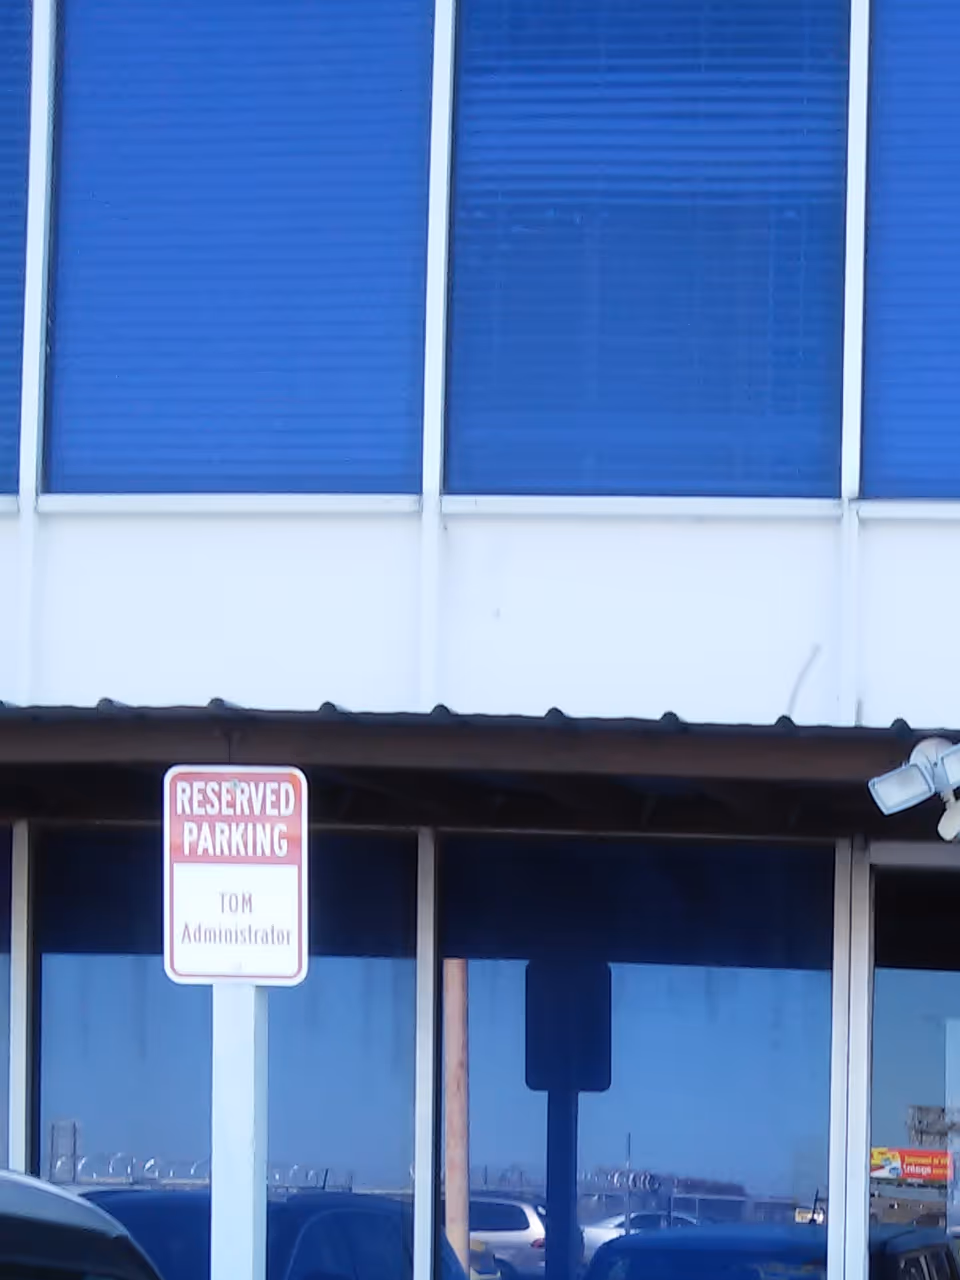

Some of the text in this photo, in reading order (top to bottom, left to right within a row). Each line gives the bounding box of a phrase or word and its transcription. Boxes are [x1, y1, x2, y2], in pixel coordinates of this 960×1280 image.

[176, 781, 295, 817] RESERVED
[183, 821, 288, 858] PARKING
[219, 891, 253, 914] TOM
[181, 921, 291, 946] Administrator
